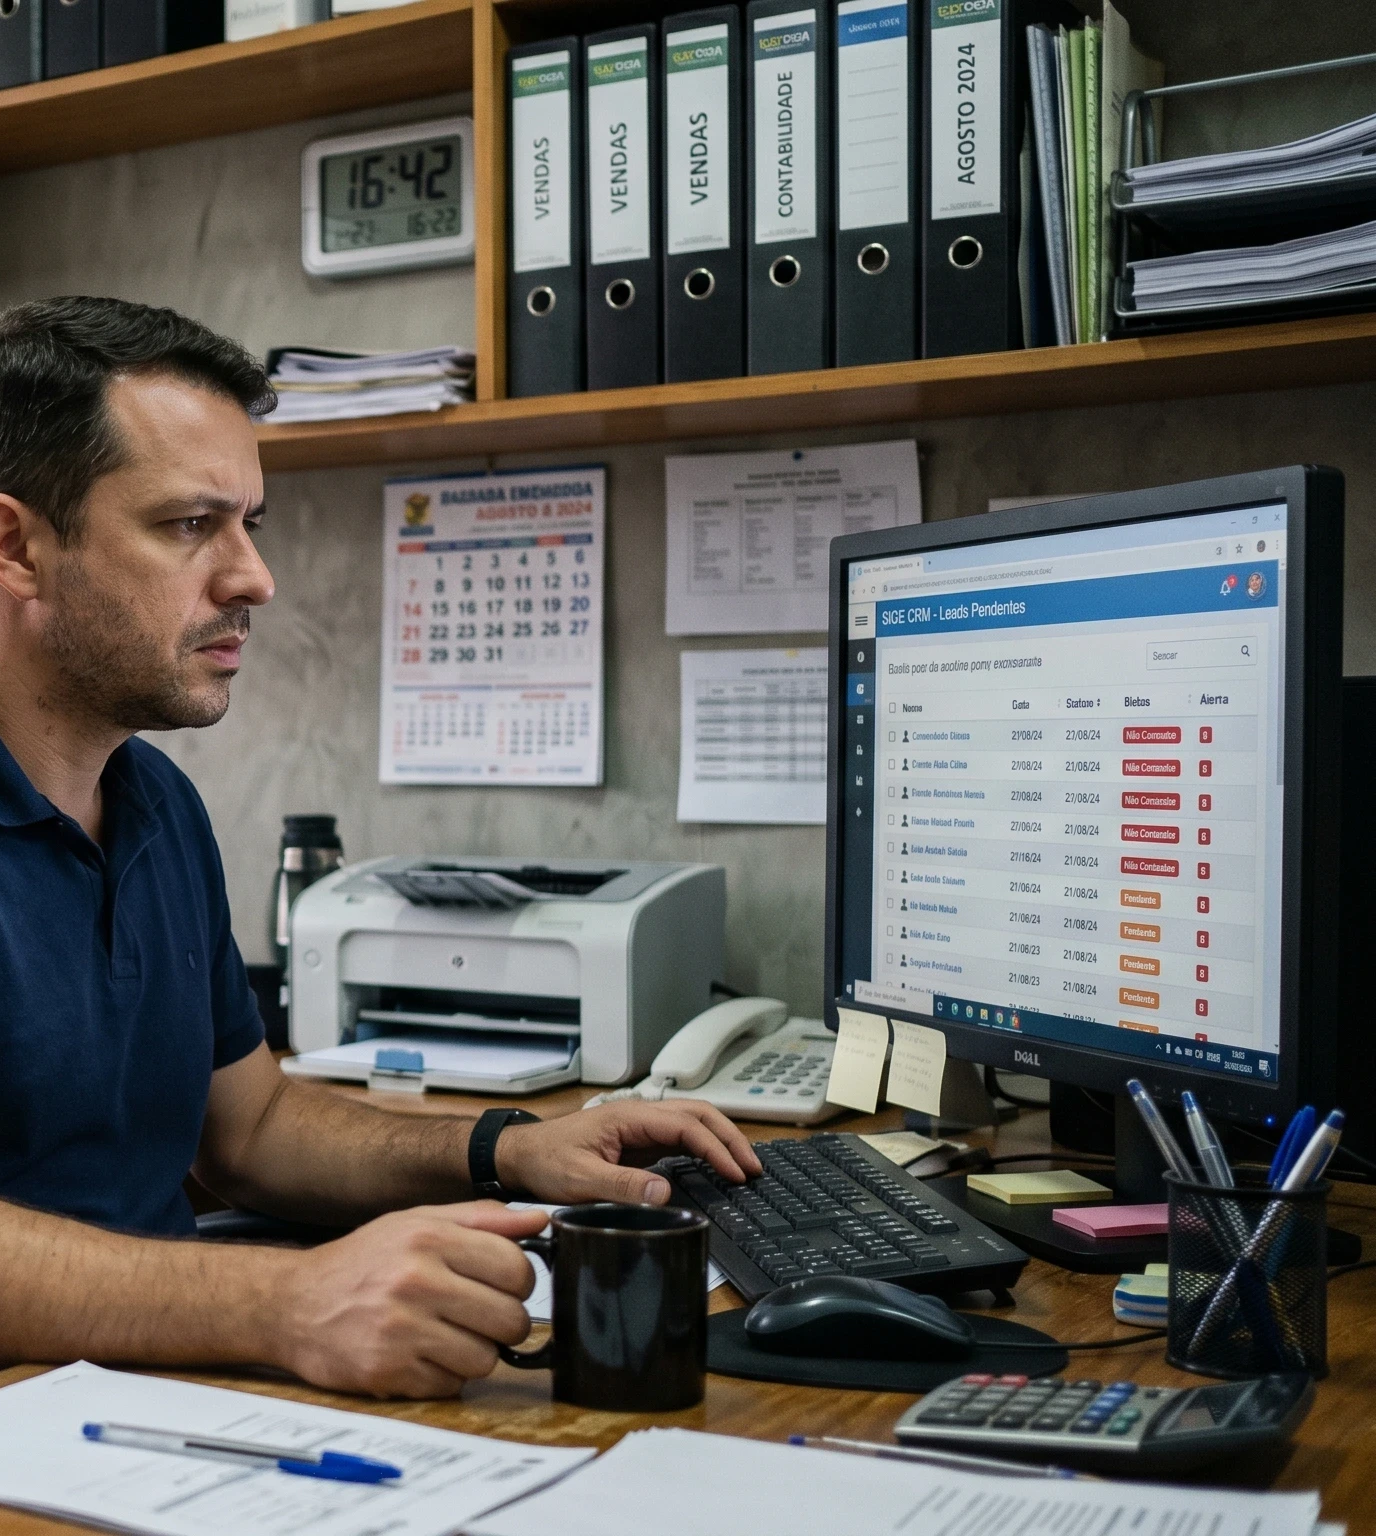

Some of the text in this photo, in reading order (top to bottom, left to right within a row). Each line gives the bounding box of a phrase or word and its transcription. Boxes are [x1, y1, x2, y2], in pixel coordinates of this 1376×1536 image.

[956, 42, 976, 186] AGOSTO 2024
[690, 111, 709, 206] VENDAS
[778, 70, 794, 218] CONTABILIDADE
[348, 144, 453, 210] 16:42
[534, 136, 550, 221] VENDAS
[610, 122, 628, 214] VENDAS
[436, 549, 585, 571] 1 2 3 4 5 6
[409, 572, 590, 594] 7 8 9 10 11 12 13
[402, 618, 590, 640] 21 22 23 24 25 26 27
[403, 596, 591, 617] 14 15 16 17 18 19 20
[882, 609, 906, 625] SIGE
[907, 607, 932, 623] CRM
[940, 604, 969, 620] Leads
[971, 600, 1026, 618] Pendentes
[402, 646, 503, 664] 28 29 30 31
